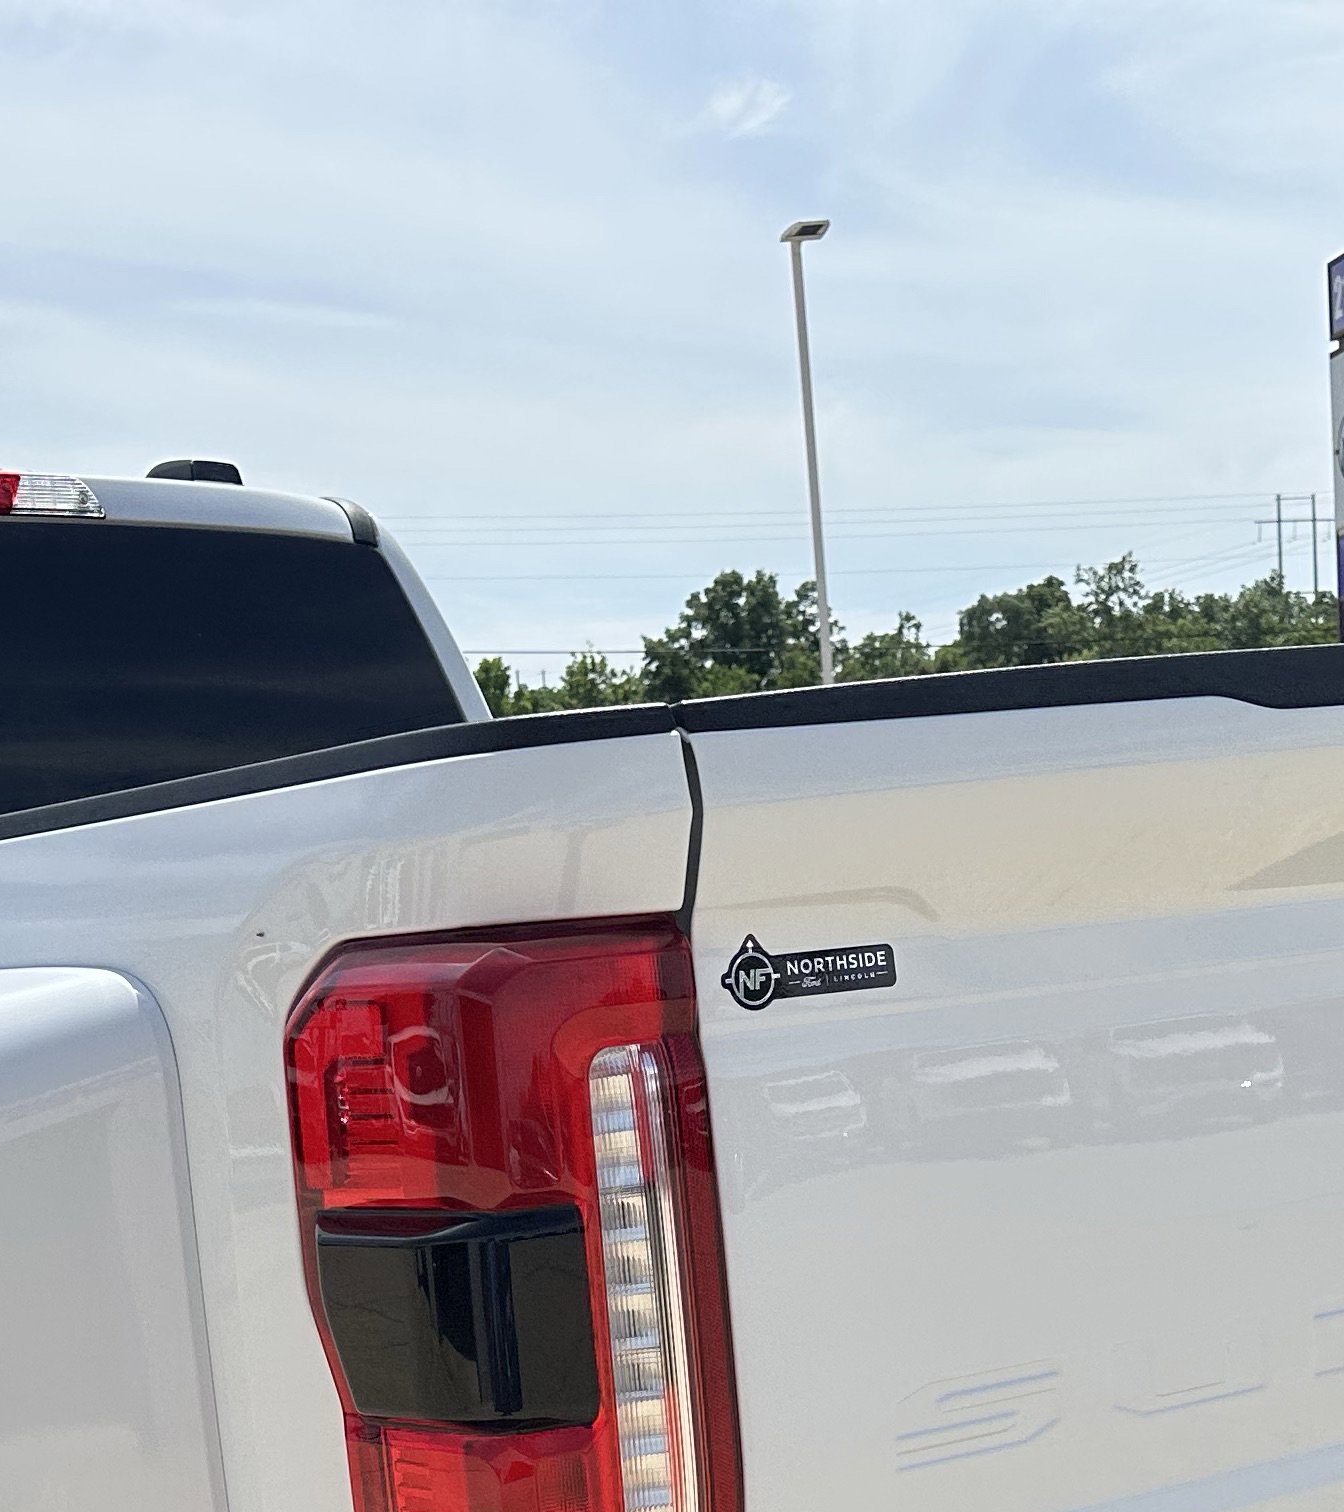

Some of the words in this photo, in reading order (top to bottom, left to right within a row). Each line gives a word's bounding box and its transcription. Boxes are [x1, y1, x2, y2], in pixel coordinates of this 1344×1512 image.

[786, 951, 887, 976] NORTHSIDE
[738, 967, 772, 999] NF
[801, 976, 822, 988] Ford
[833, 972, 875, 983] LINCOLN
